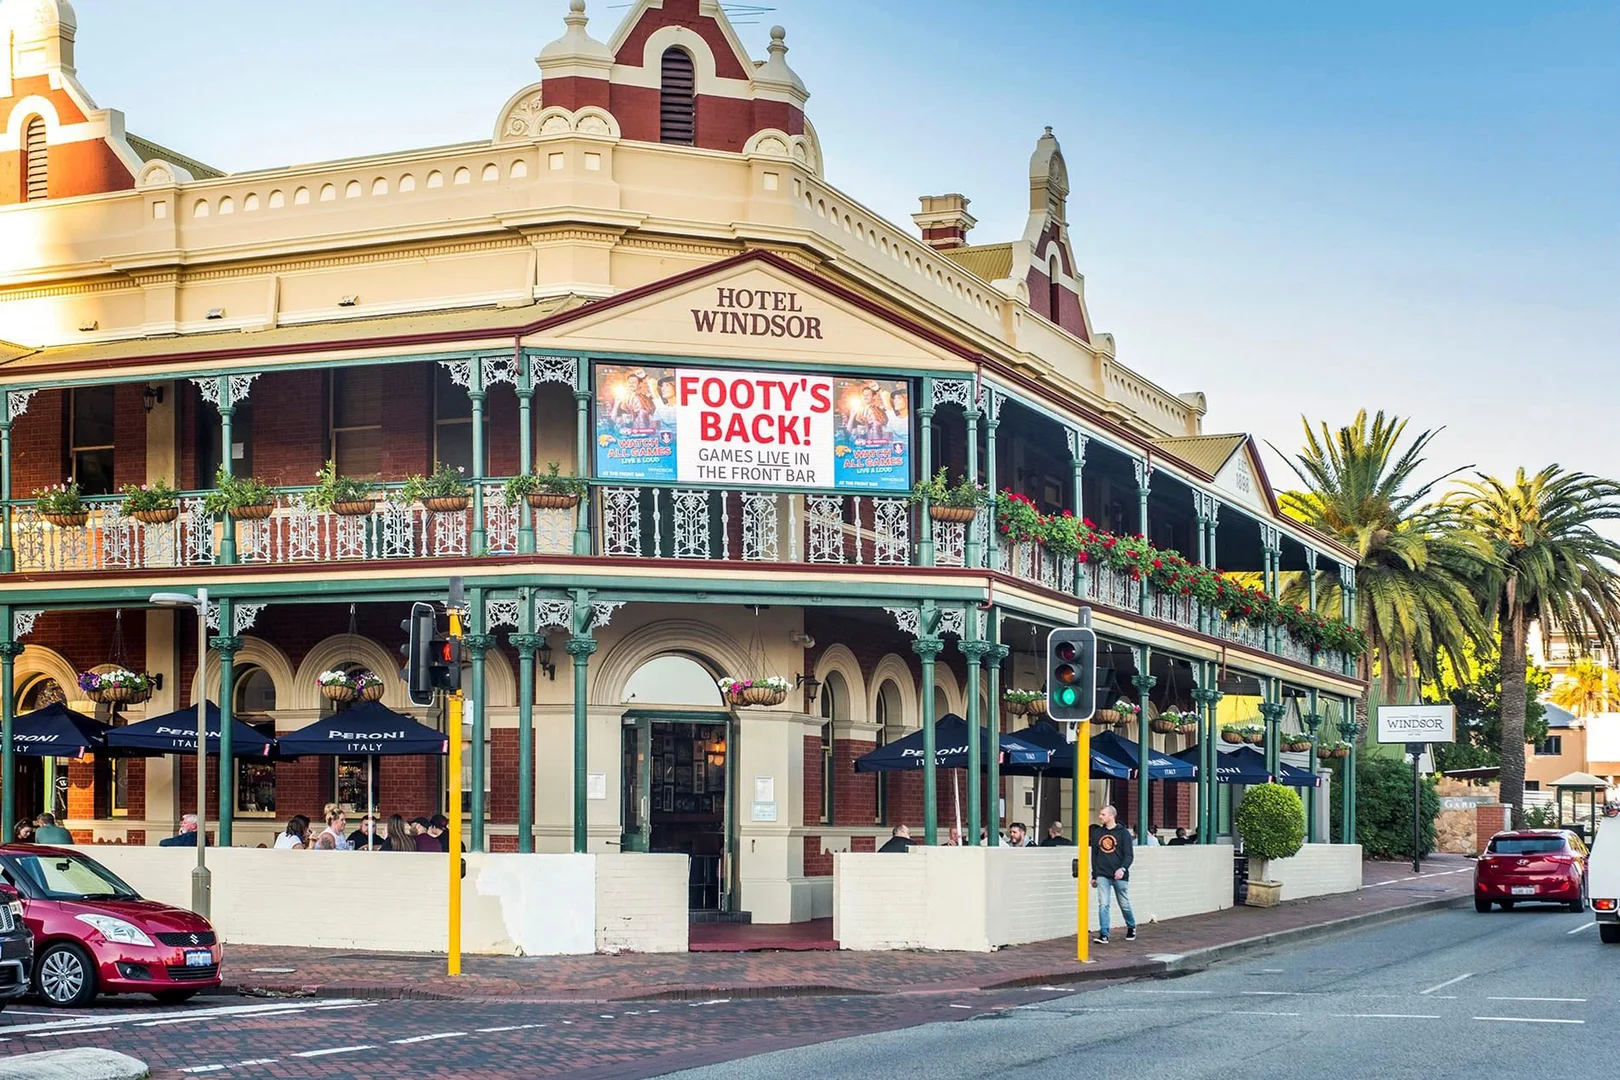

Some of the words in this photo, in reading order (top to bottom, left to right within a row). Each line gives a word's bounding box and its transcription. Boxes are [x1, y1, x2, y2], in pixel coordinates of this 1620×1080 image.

[717, 287, 802, 312] HOTEL
[691, 309, 823, 339] WINDSOR
[680, 376, 831, 413] FOOTY'S
[700, 411, 811, 446] BACK!
[618, 438, 658, 448] WATCH
[608, 449, 630, 458] ALL
[631, 447, 671, 457] GAMES
[699, 448, 753, 463] GAMES
[757, 450, 790, 465] LIVE
[795, 452, 809, 465] IN
[853, 449, 891, 459] WATCH
[843, 459, 864, 468] ALL
[865, 457, 903, 467] GAMES
[697, 465, 727, 479] THE
[732, 466, 781, 481] FRONT
[786, 469, 815, 482] BAR
[1387, 719, 1444, 729] WINDSOR
[156, 726, 222, 737] PERON
[329, 730, 405, 739] PERONI
[173, 739, 198, 747] ITAL
[347, 743, 383, 751] ITALY
[901, 746, 969, 757] PEONI
